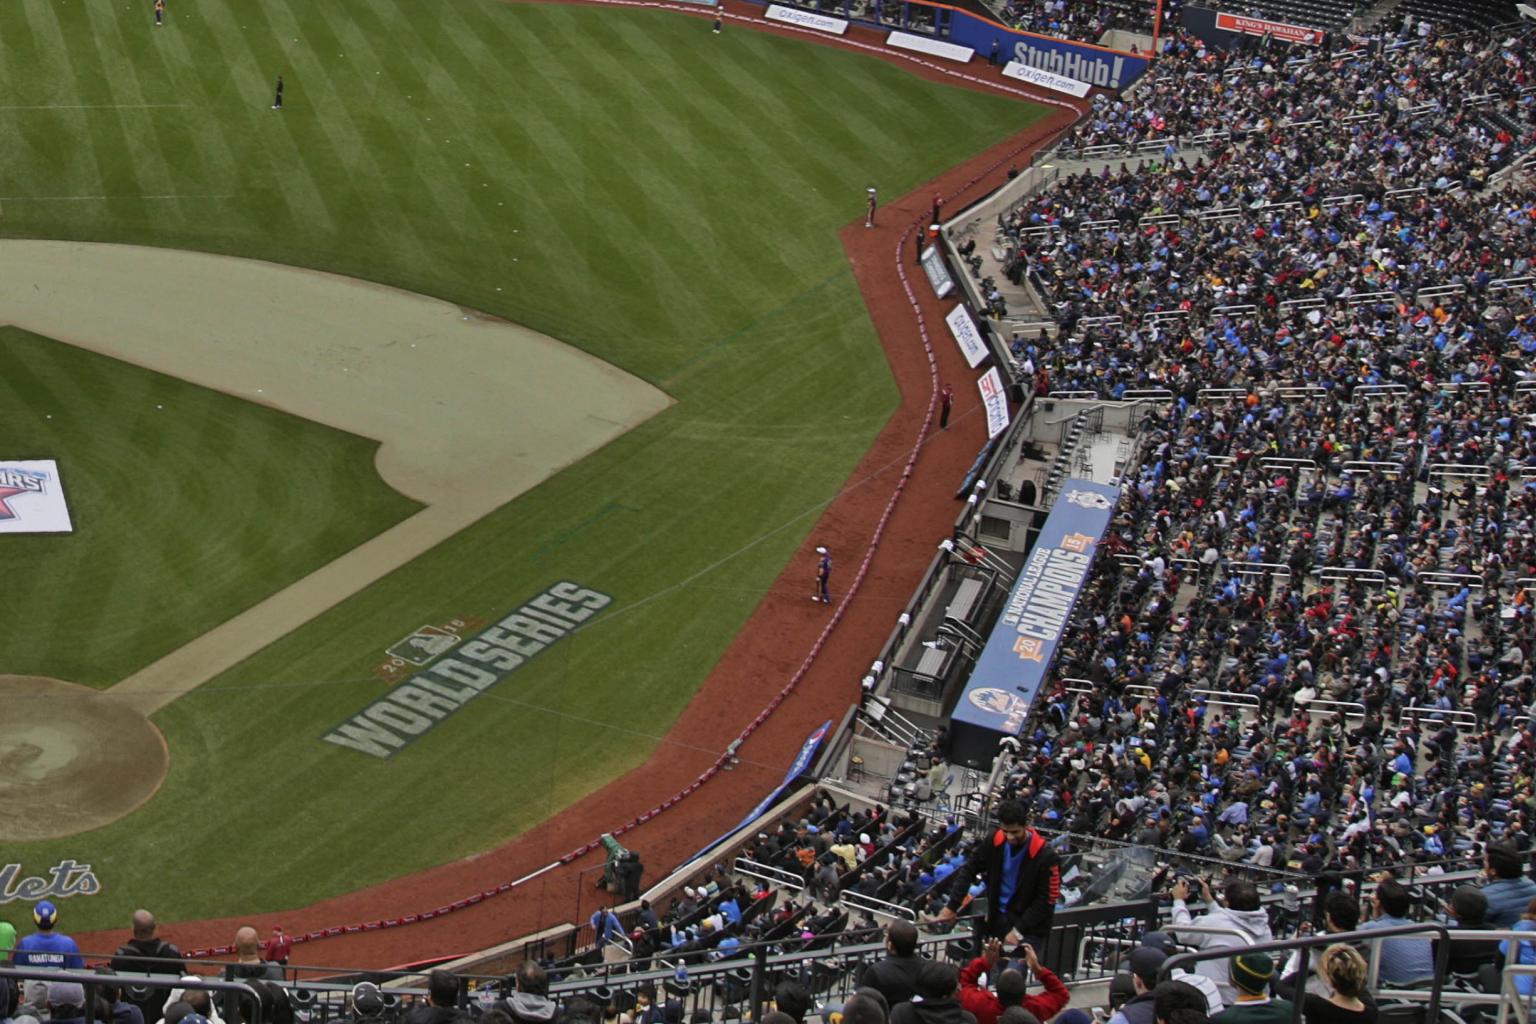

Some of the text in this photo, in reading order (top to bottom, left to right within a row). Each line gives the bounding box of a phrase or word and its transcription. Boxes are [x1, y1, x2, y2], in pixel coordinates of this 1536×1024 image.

[1014, 41, 1125, 89] StubHub!
[1016, 548, 1090, 641] CHAMPIONS
[1027, 547, 1051, 578] LEAGUE
[322, 581, 612, 758] WORLD SERIES
